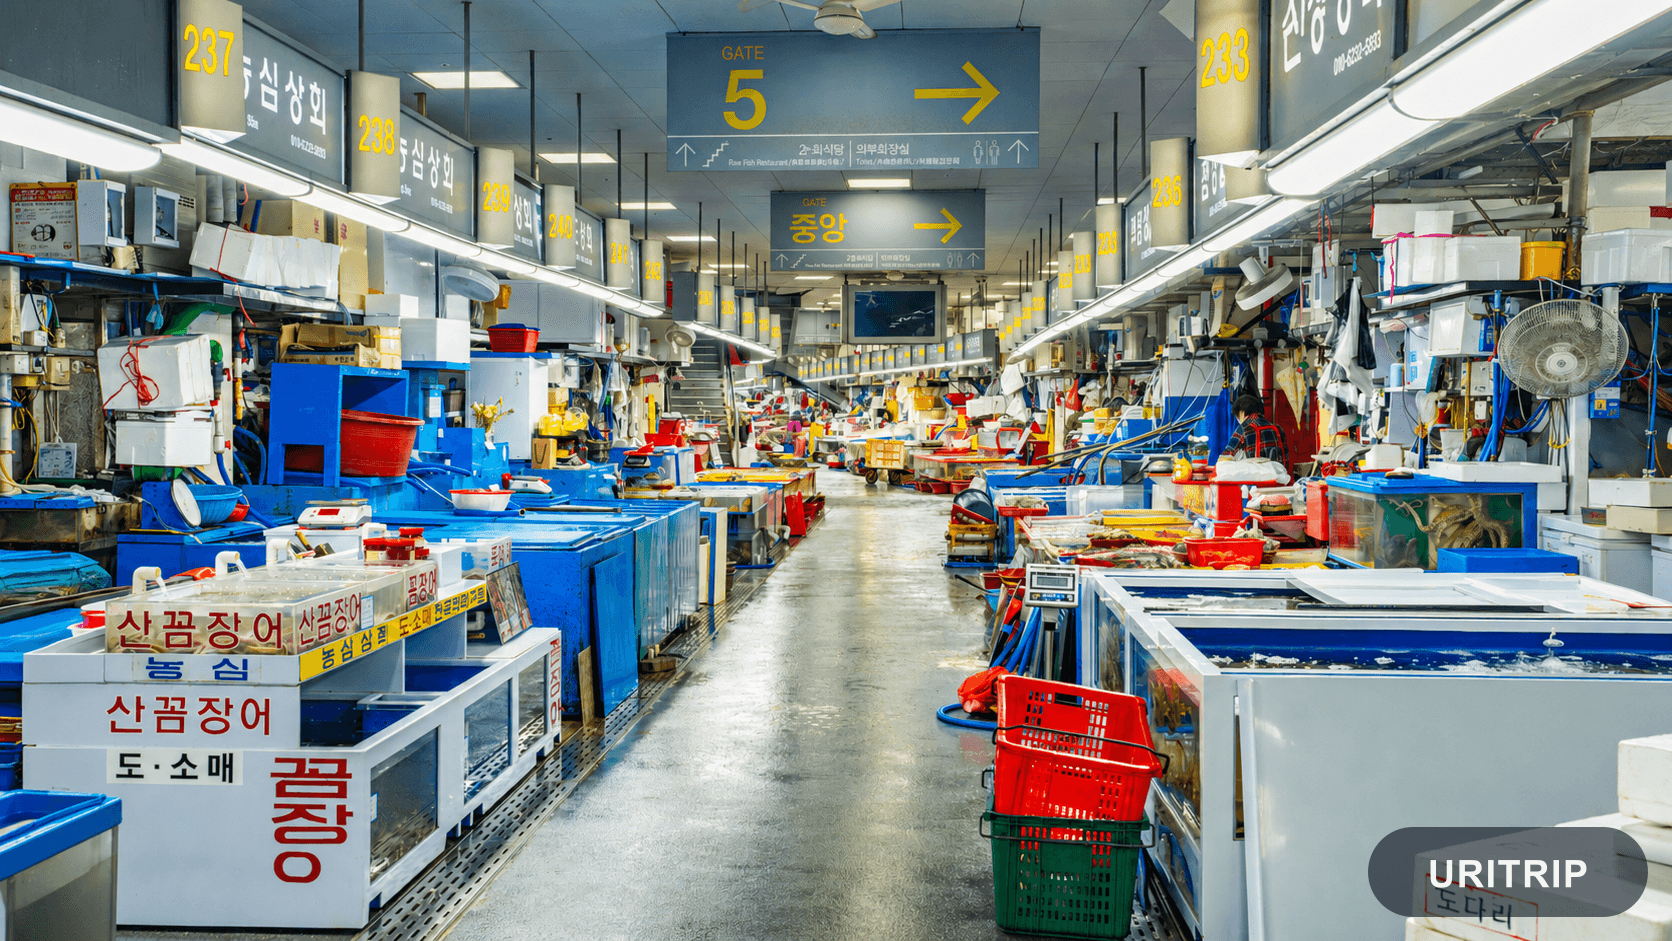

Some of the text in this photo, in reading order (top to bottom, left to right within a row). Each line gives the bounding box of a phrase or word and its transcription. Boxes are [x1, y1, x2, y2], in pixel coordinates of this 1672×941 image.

[183, 23, 235, 77] 237
[721, 45, 765, 61] GATE
[1200, 27, 1250, 89] 233
[722, 69, 767, 131] 5
[358, 114, 395, 156] 238
[483, 181, 511, 213] 239
[802, 198, 827, 207] GATE
[548, 213, 573, 239] 240
[789, 212, 848, 244] 중앙
[117, 610, 283, 650] 산꼼장어
[299, 592, 361, 646] 산꼼장어
[106, 695, 272, 736] 산꼼장어
[1435, 886, 1512, 930] 도다리
